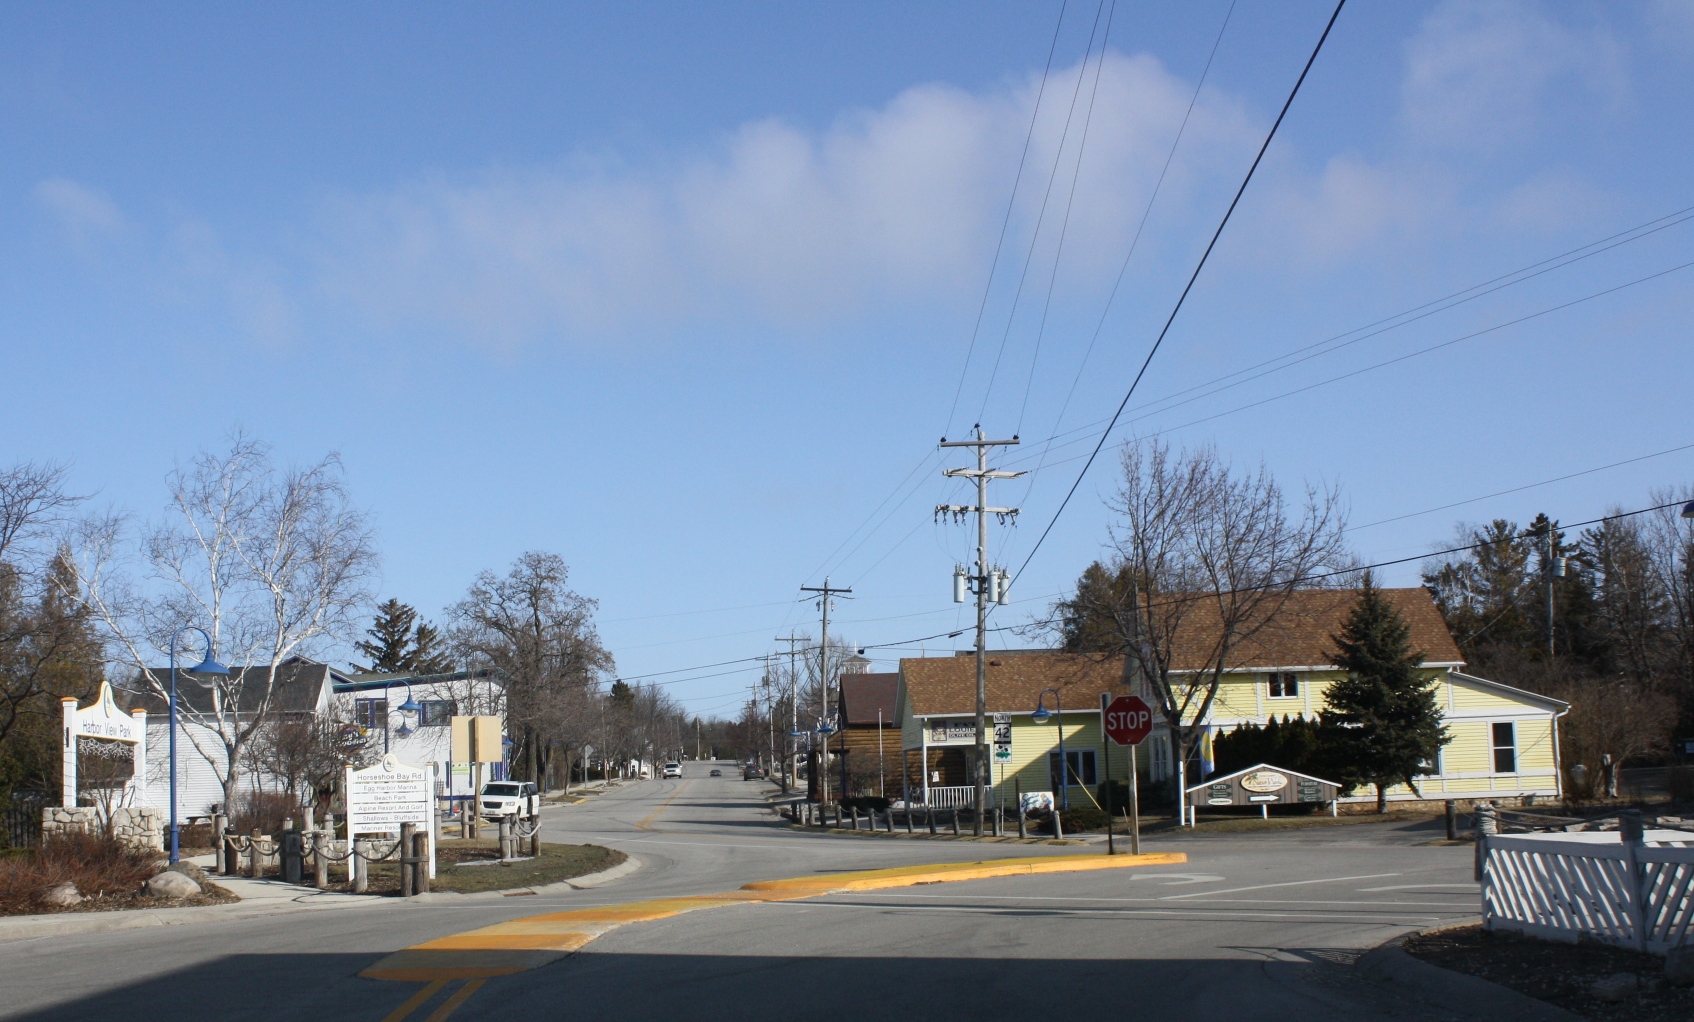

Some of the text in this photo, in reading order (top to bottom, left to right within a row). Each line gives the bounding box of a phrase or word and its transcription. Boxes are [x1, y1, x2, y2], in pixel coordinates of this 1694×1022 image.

[1107, 710, 1149, 730] STOP
[82, 719, 132, 738] Harbor View Park
[995, 727, 1010, 738] 42
[396, 773, 410, 781] Bay
